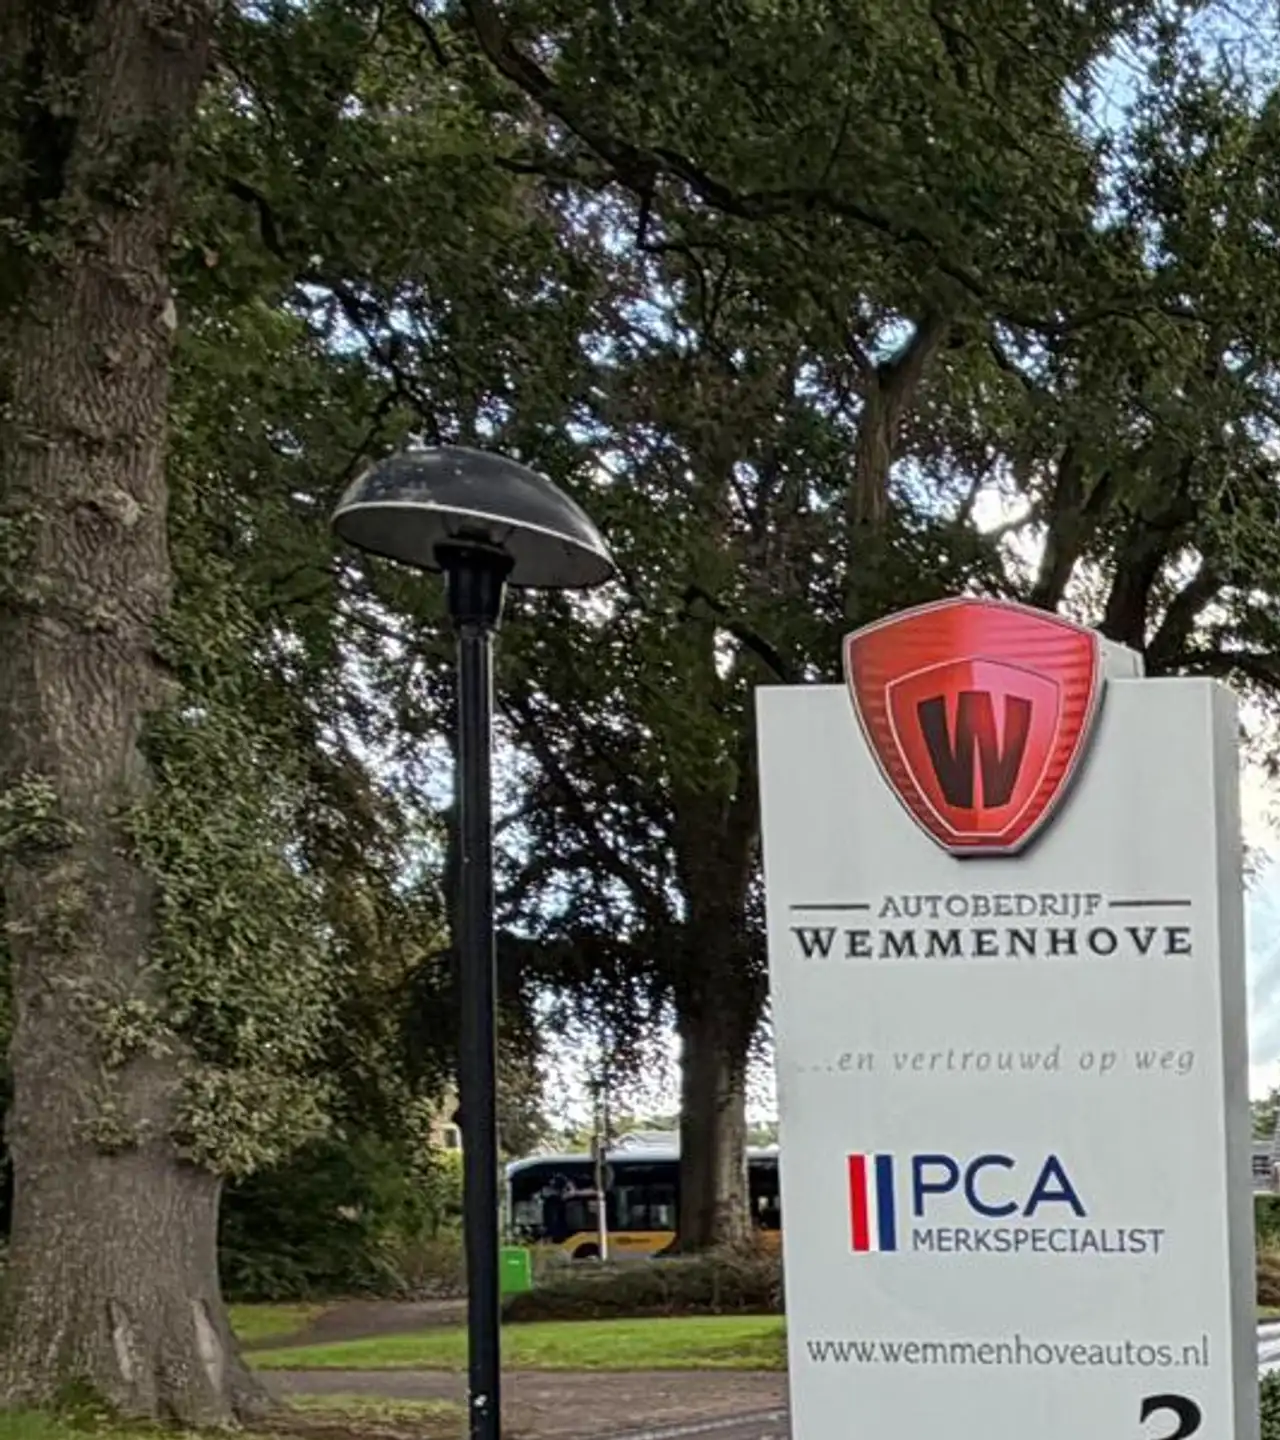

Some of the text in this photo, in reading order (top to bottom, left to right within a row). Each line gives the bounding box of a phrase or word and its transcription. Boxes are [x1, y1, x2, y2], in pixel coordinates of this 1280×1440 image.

[916, 690, 1033, 809] W
[877, 893, 1103, 920] AUTOBEDRIJF
[788, 925, 1193, 960] WEMMENHOVE
[893, 1042, 1061, 1073] vertrouwd
[1078, 1050, 1117, 1075] op
[1134, 1049, 1196, 1077] weg
[911, 1153, 1087, 1218] PCA
[912, 1227, 1167, 1255] MERKSPECIALIST
[805, 1333, 1210, 1368] www.wemmenhoveautos.nl
